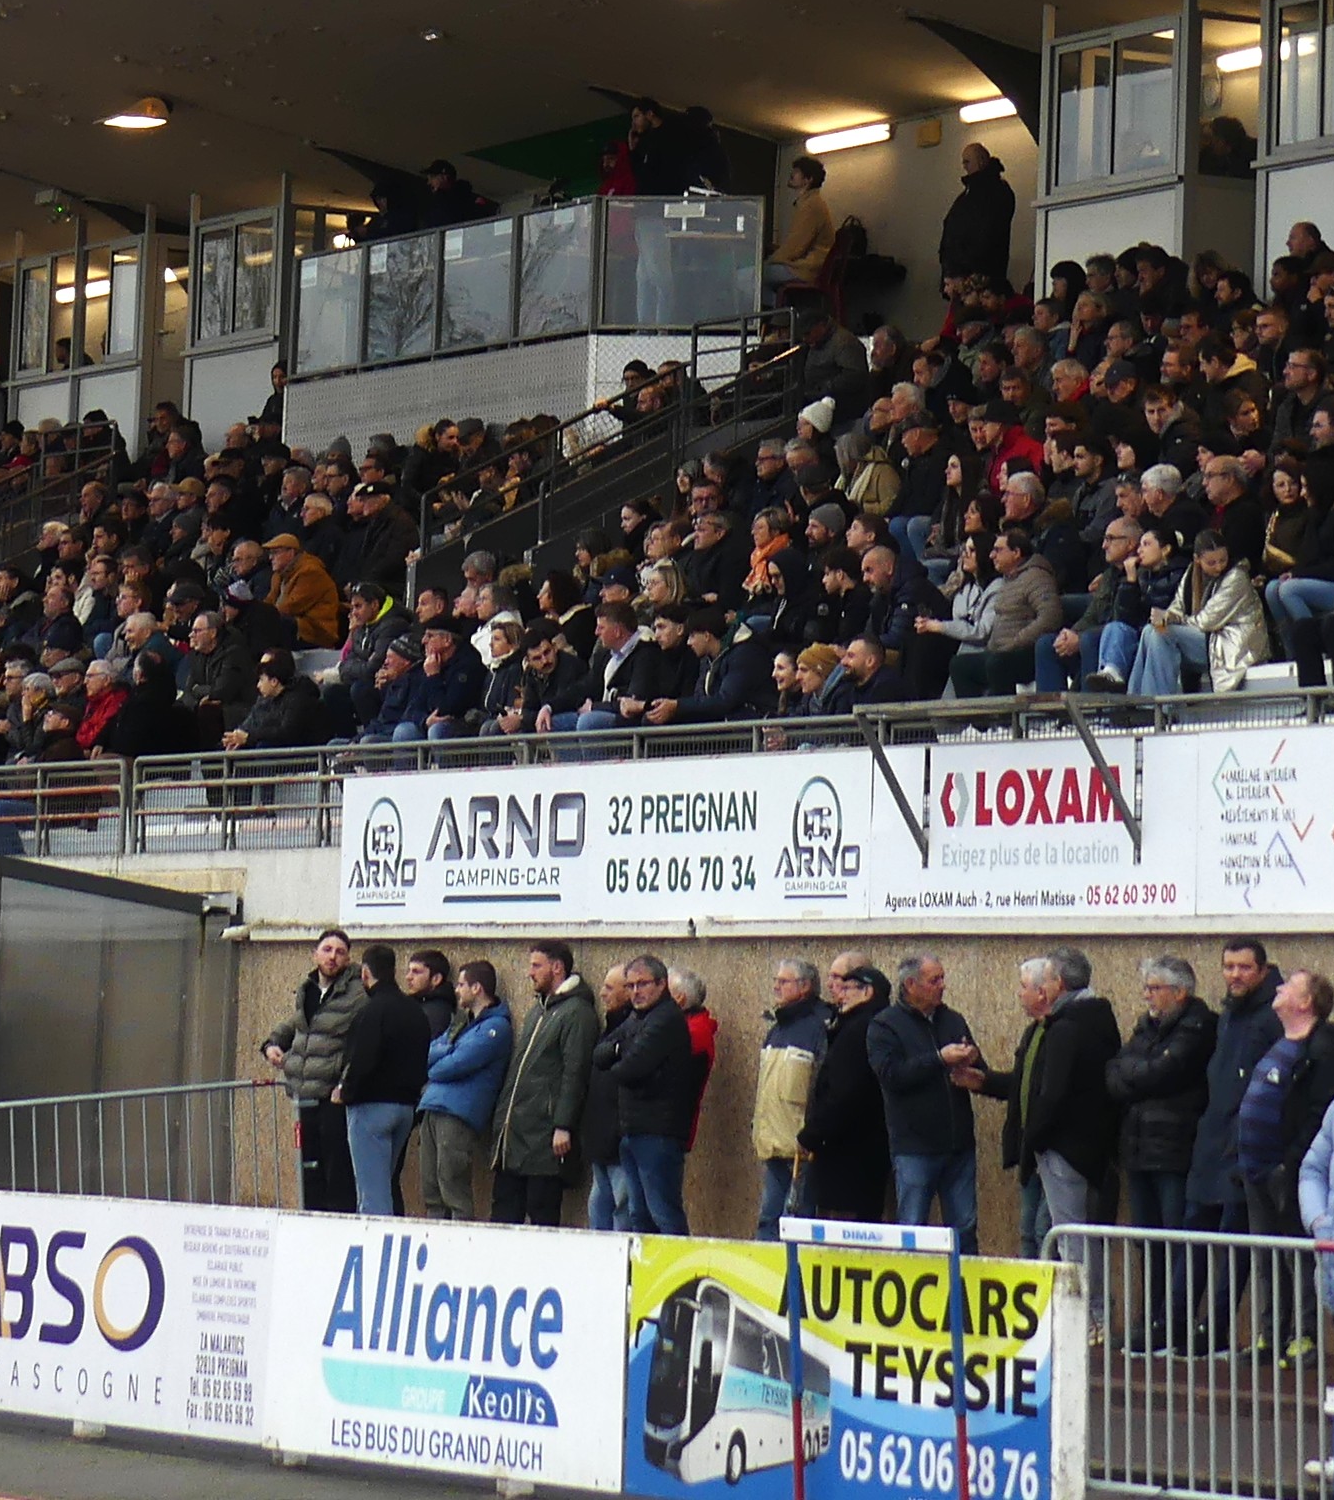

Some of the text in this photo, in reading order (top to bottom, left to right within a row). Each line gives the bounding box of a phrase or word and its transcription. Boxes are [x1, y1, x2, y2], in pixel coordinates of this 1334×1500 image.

[608, 790, 758, 835] 32 PREIGNAN
[975, 765, 1125, 827] LOXAM
[425, 792, 586, 861] ARNO
[774, 845, 861, 878] ARNO
[941, 839, 1119, 872] Exigez plus de la location
[348, 858, 417, 888] ARNO
[445, 867, 560, 887] CAMPING-CAR
[606, 855, 757, 893] 05 62 06 70 34
[784, 880, 848, 891] CAMPING-CAR
[356, 891, 406, 900] CAMPING-CAR
[885, 883, 1177, 913] Agence LOXAM Auch 2, rue Henri Matisse 05 62 60 39 00
[322, 1233, 563, 1370] Alliance
[779, 1261, 1039, 1341] AUTOCARS
[200, 1332, 208, 1351] ZA
[217, 1356, 247, 1378] PREIGNAN
[844, 1341, 1038, 1418] TEYSSIE
[202, 1378, 211, 1398] 05
[468, 1374, 548, 1424] Keolis
[204, 1401, 212, 1421] 05
[331, 1417, 543, 1471] LES BUS DU GRAND AUCH
[840, 1429, 873, 1483] 05
[878, 1434, 913, 1489] 62
[919, 1438, 954, 1494] 06
[1001, 1448, 1039, 1500] 76
